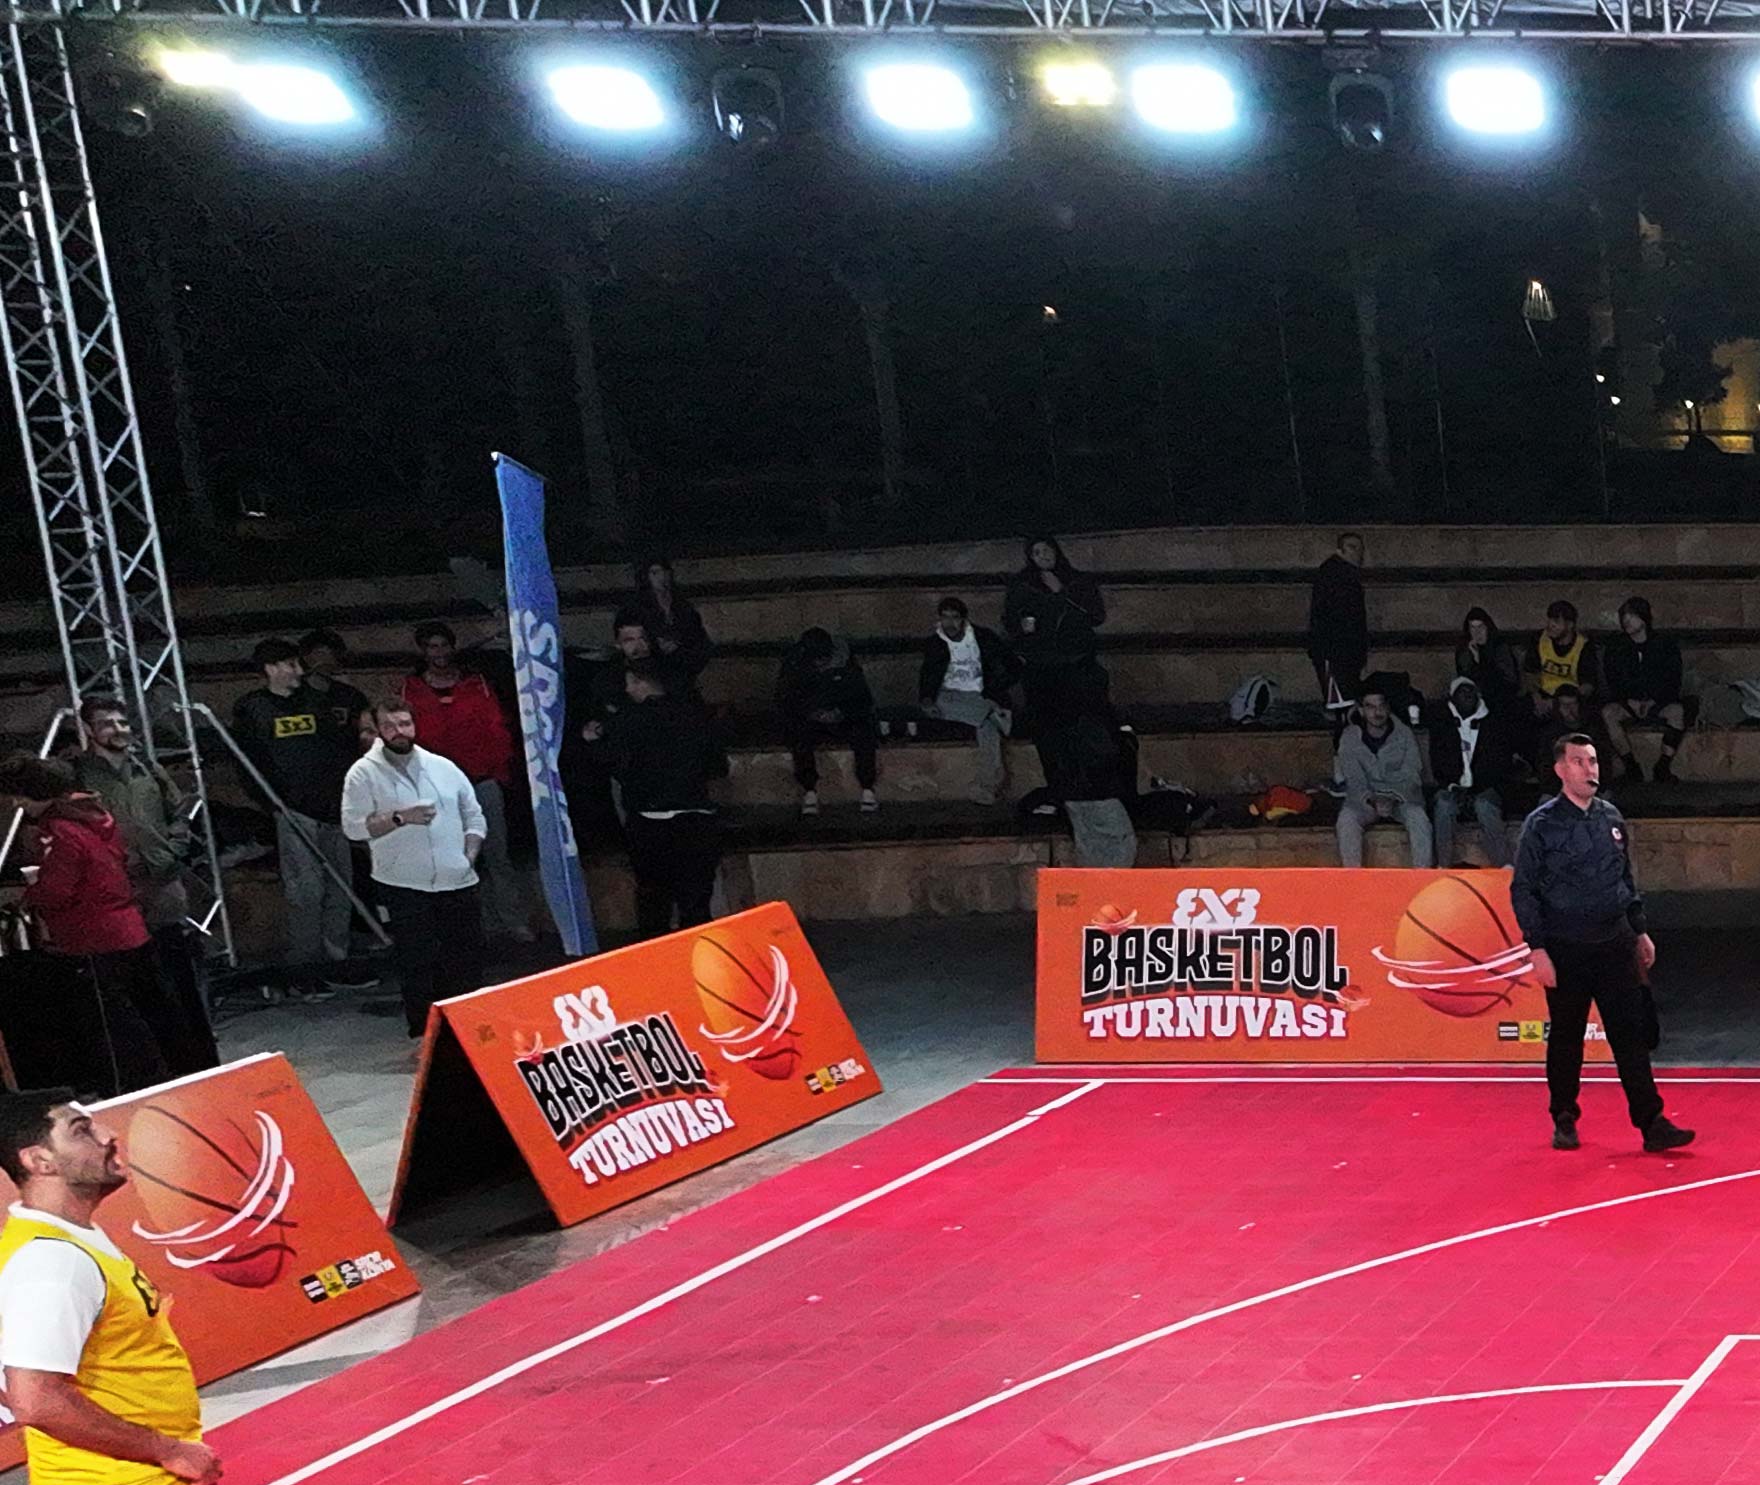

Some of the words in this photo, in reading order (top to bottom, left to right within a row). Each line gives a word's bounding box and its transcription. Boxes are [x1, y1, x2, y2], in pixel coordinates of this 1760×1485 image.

[1082, 924, 1349, 998] BASKETBOL
[1083, 996, 1347, 1039] TURNUVASI
[515, 1010, 707, 1141] BASKETBOL
[568, 1099, 736, 1185] TURNUVASI
